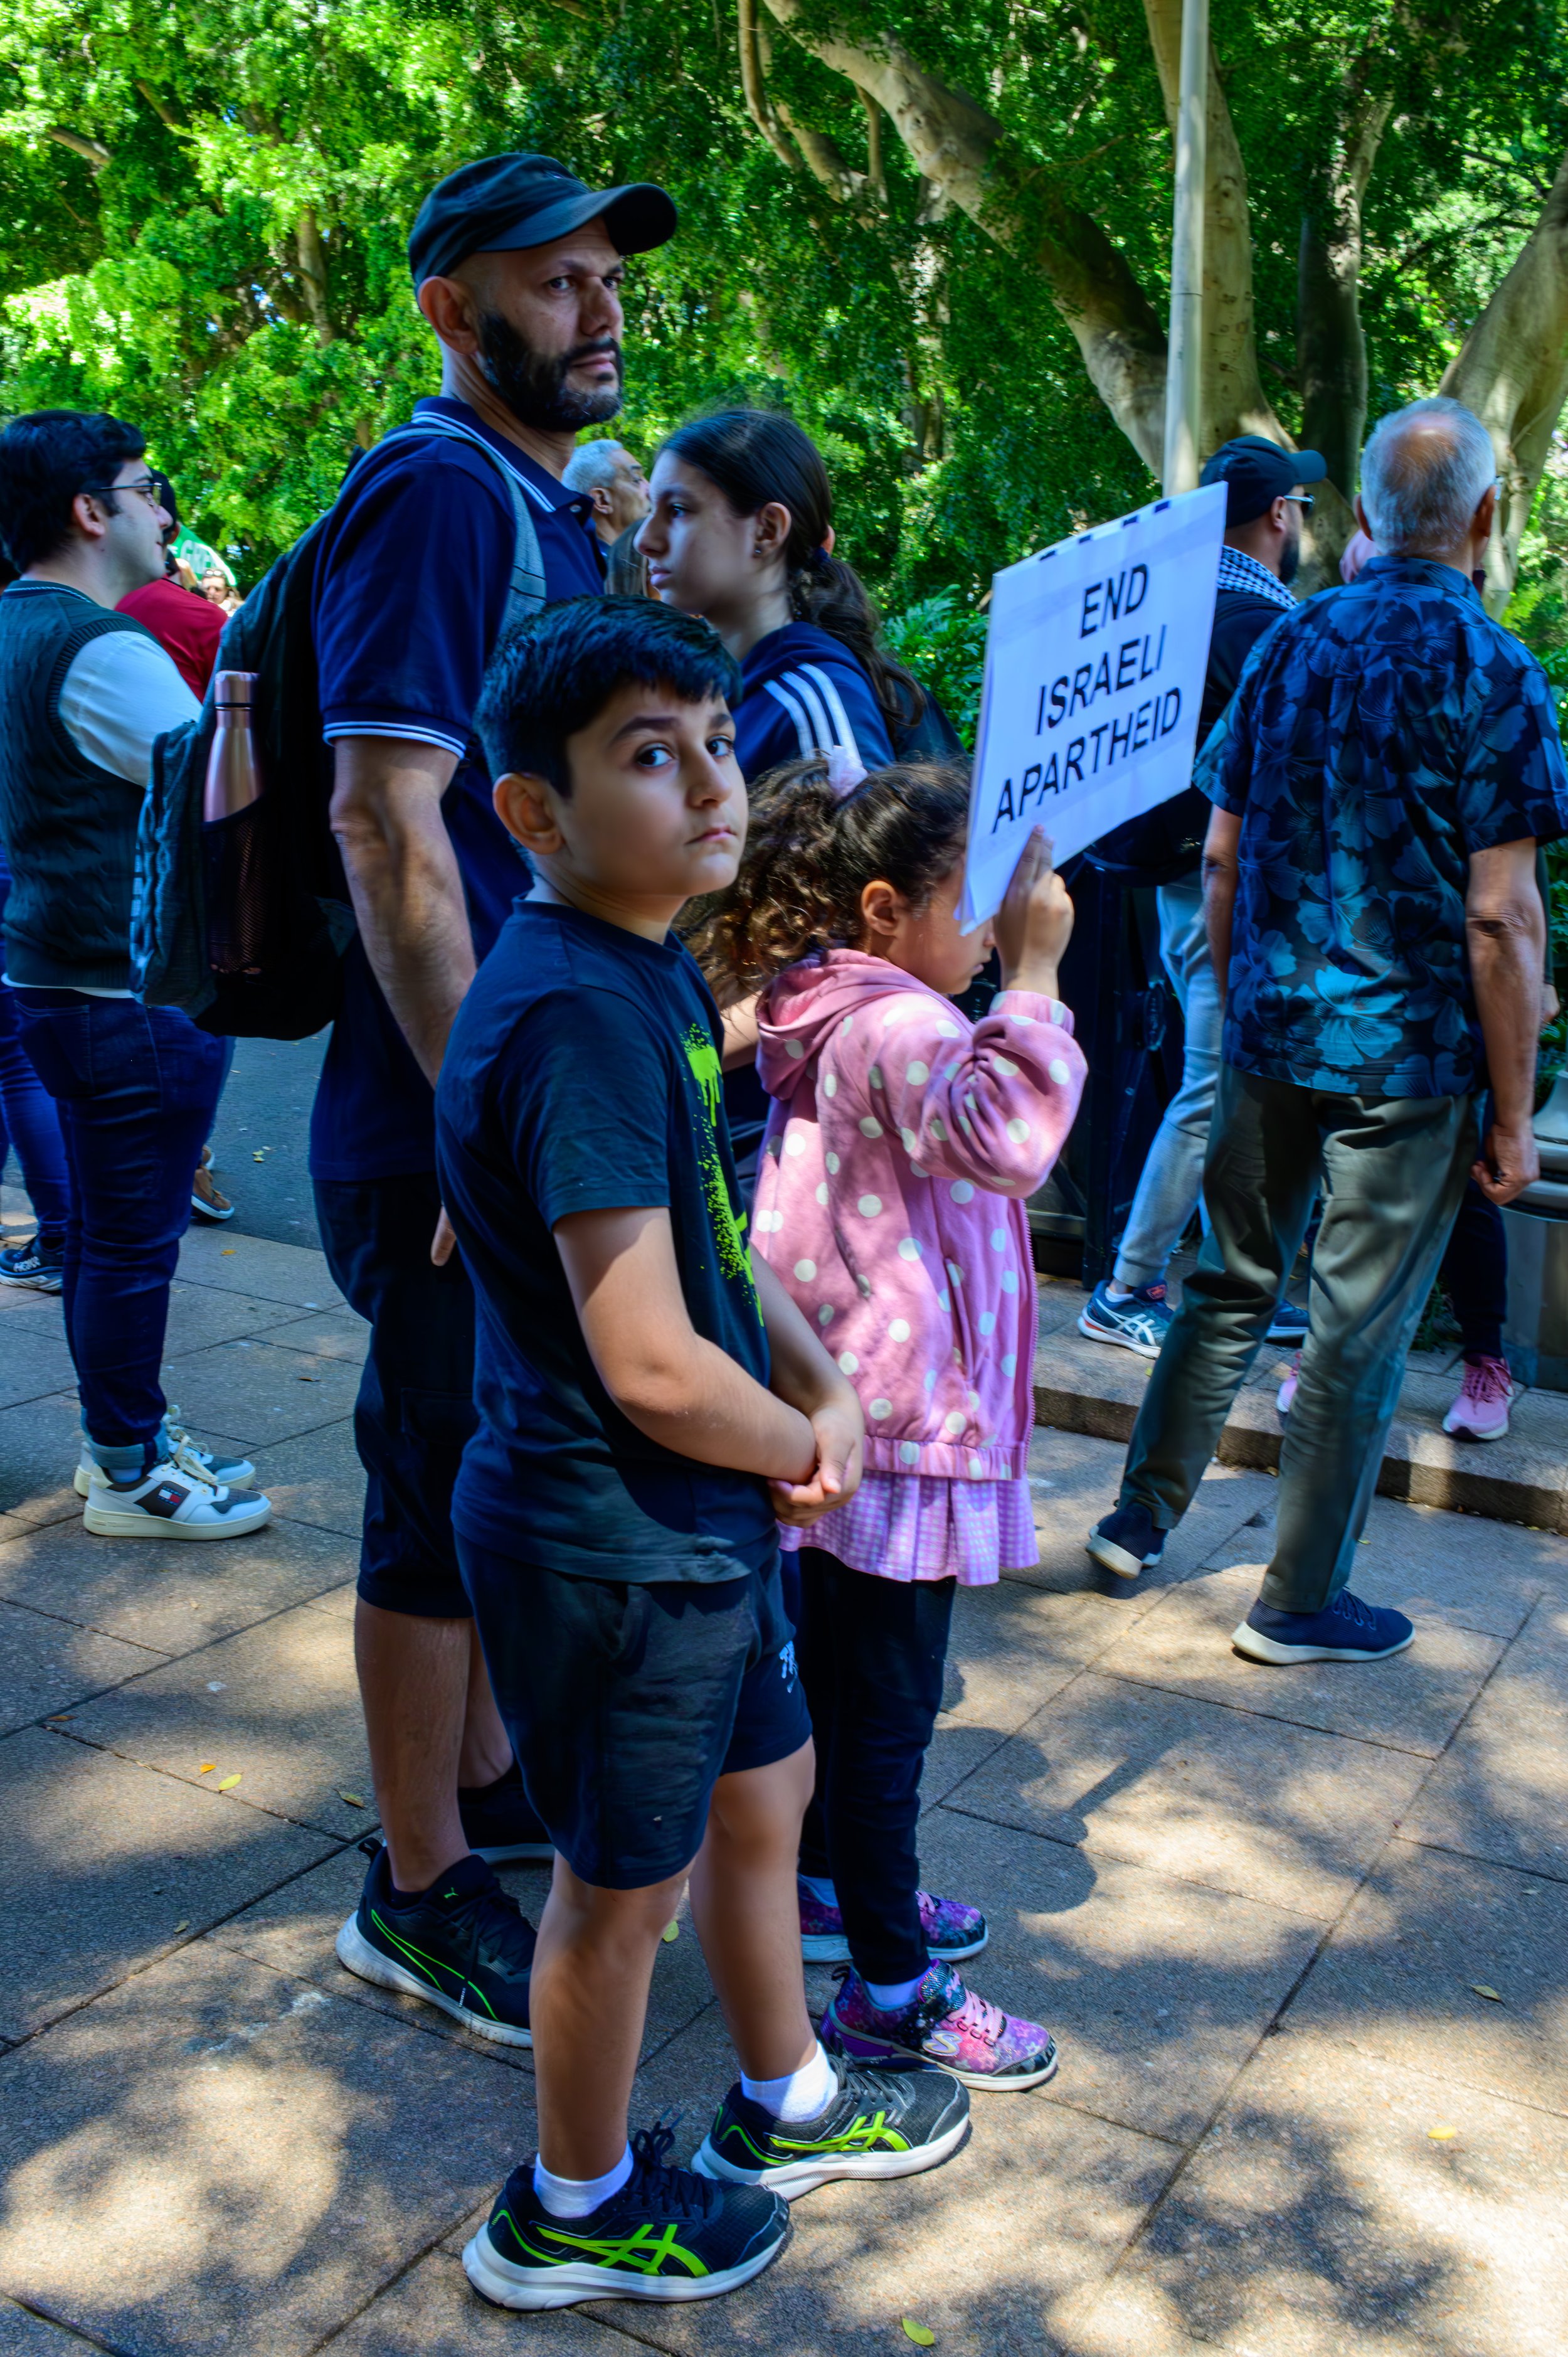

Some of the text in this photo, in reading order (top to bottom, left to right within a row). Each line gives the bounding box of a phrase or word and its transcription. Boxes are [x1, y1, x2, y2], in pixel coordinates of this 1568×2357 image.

[1079, 563, 1149, 639] END
[1036, 625, 1167, 736] ISRAELI
[991, 687, 1182, 834] APARTHEID
